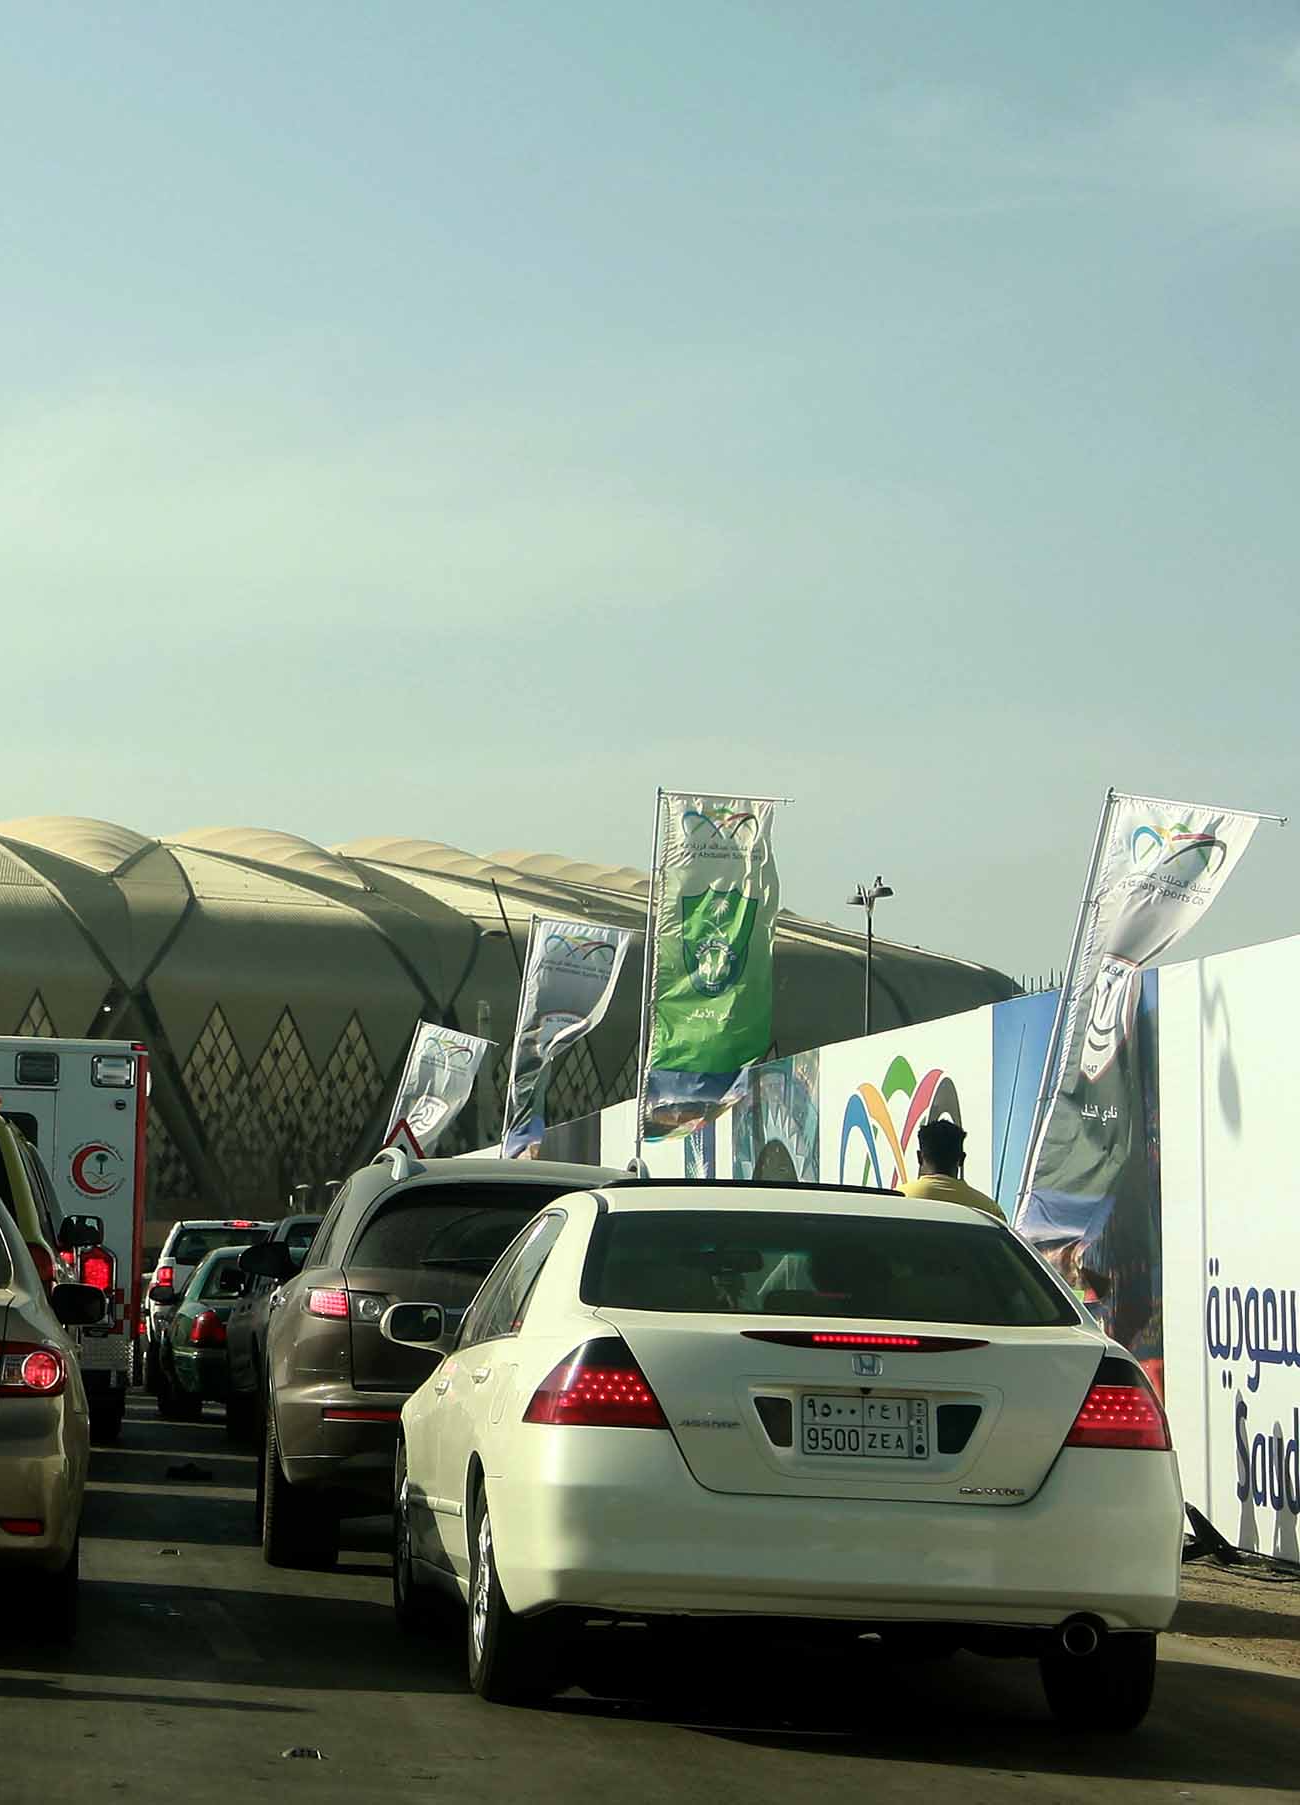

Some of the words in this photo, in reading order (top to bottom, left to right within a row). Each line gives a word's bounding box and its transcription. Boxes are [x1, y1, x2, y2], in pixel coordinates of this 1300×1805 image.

[1157, 886, 1190, 903] Sports
[1101, 1105, 1118, 1127] نادي
[807, 1427, 860, 1452] 9500
[868, 1432, 905, 1450] ZEA
